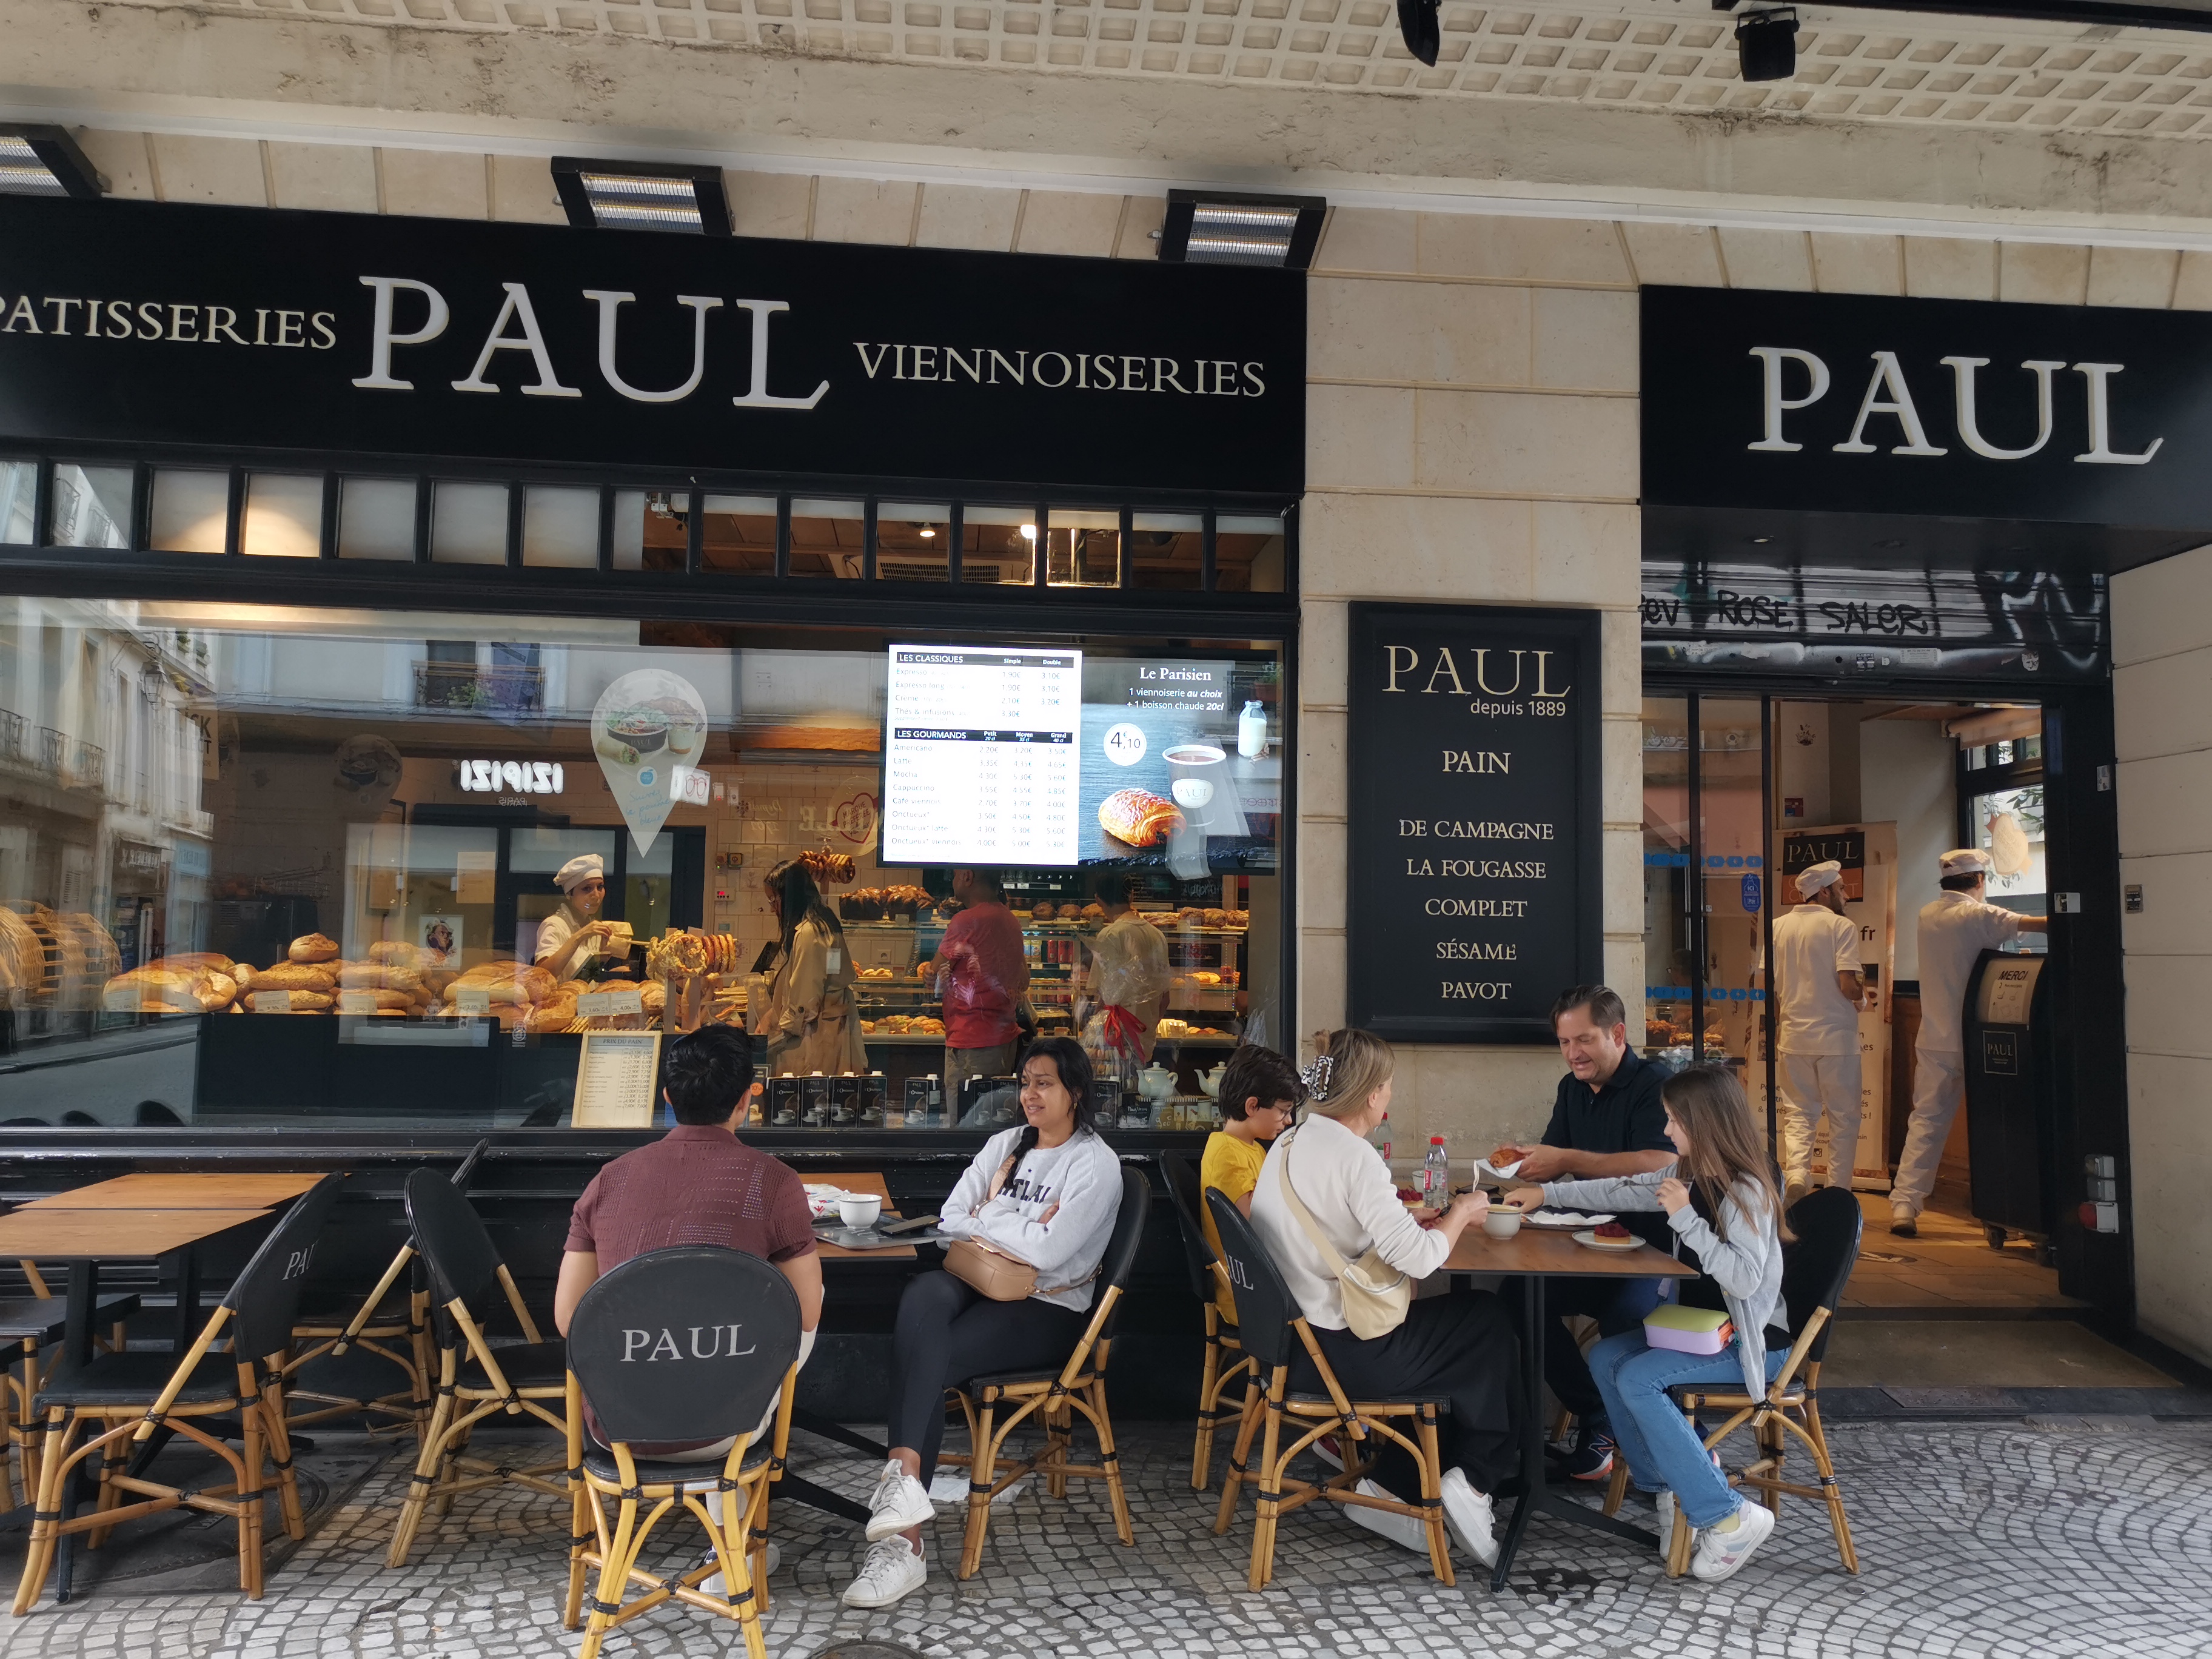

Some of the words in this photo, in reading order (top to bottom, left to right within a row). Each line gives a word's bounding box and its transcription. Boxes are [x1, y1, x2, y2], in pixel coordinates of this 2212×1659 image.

[352, 276, 830, 410] PAUL
[853, 342, 1265, 397] VIENNOISERIES
[1748, 346, 2163, 464] PAUL
[915, 655, 964, 663] CLASSIQUES
[1140, 667, 1156, 680] Le
[1160, 668, 1212, 681] Parisien
[1382, 645, 1571, 698] PAUL
[1129, 688, 1133, 696] 1
[1136, 688, 1185, 697] viennoiserie
[1200, 689, 1222, 699] choix
[1142, 700, 1173, 709] boisson
[1175, 701, 1204, 710] chaude
[1206, 702, 1224, 711] 20cl
[1470, 699, 1523, 719] depuis
[1528, 700, 1566, 717] 1889
[1442, 750, 1511, 775] PAIN
[842, 801, 866, 819] MARQUE
[1399, 819, 1427, 837] DE
[1435, 820, 1554, 841] CAMPAGNE
[1787, 841, 1860, 863] PAUL
[1406, 859, 1435, 876] LA
[1441, 859, 1547, 879] FOUGASSE
[1425, 899, 1527, 917] COMPLET
[1435, 938, 1518, 961] SÉSAME
[1999, 970, 2029, 980] MERCI
[1441, 982, 1512, 1000] PAVOT
[1987, 1043, 2014, 1056] PAUL
[620, 1324, 757, 1362] PAUL
